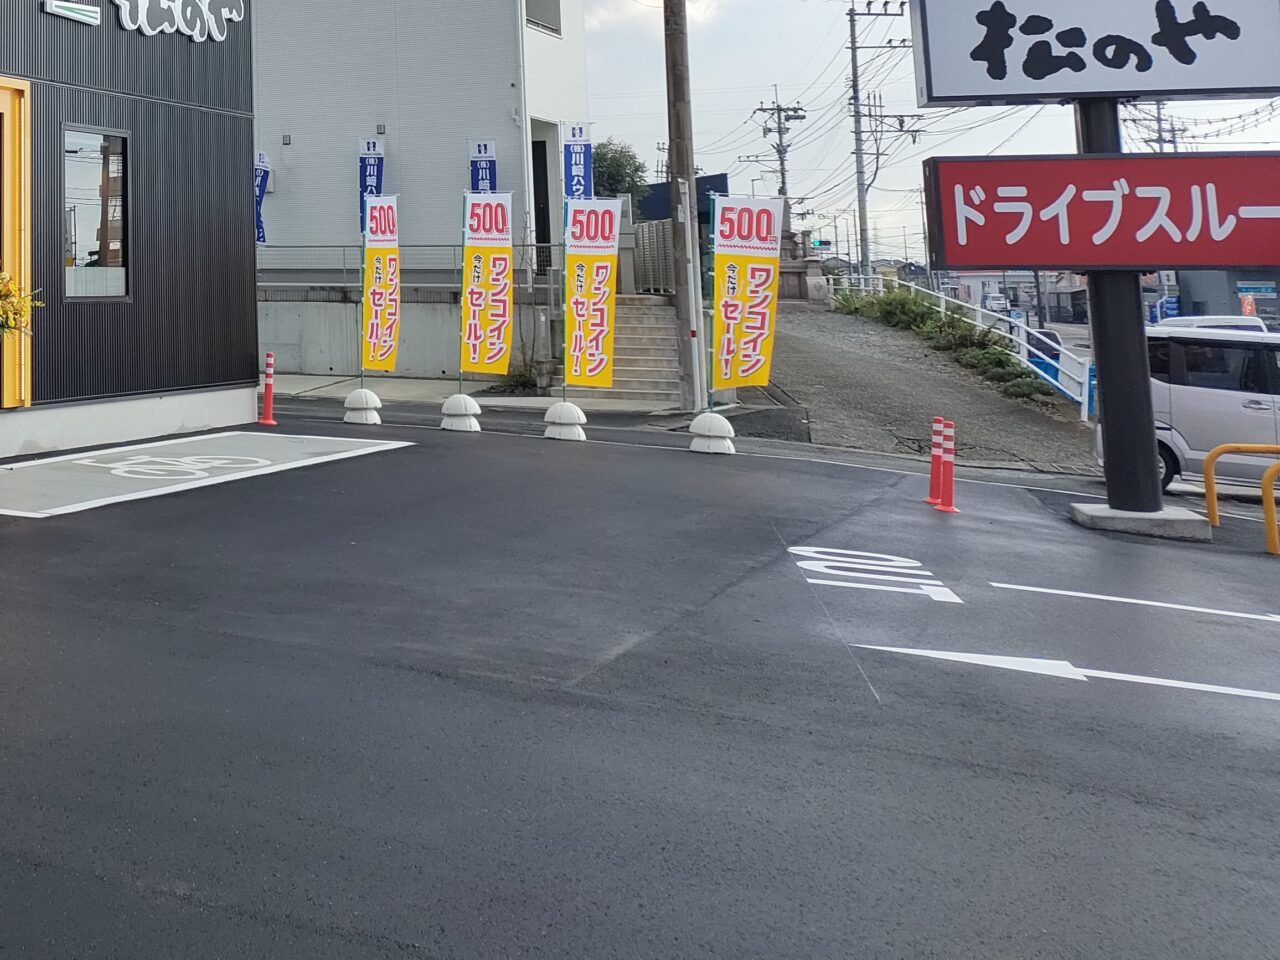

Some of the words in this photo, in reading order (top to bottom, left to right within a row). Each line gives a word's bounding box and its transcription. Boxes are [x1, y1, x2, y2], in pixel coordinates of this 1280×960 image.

[954, 178, 1280, 246] ドライブスルー
[374, 255, 383, 284] 今だけ
[472, 254, 483, 283] 今だけ
[575, 263, 586, 293] 今だけ
[726, 263, 738, 295] 今だけ
[378, 257, 398, 360] ワンコイン
[486, 256, 509, 363] ワンコイン
[588, 263, 611, 375] ワンコイン
[741, 266, 773, 376] ワンコイン
